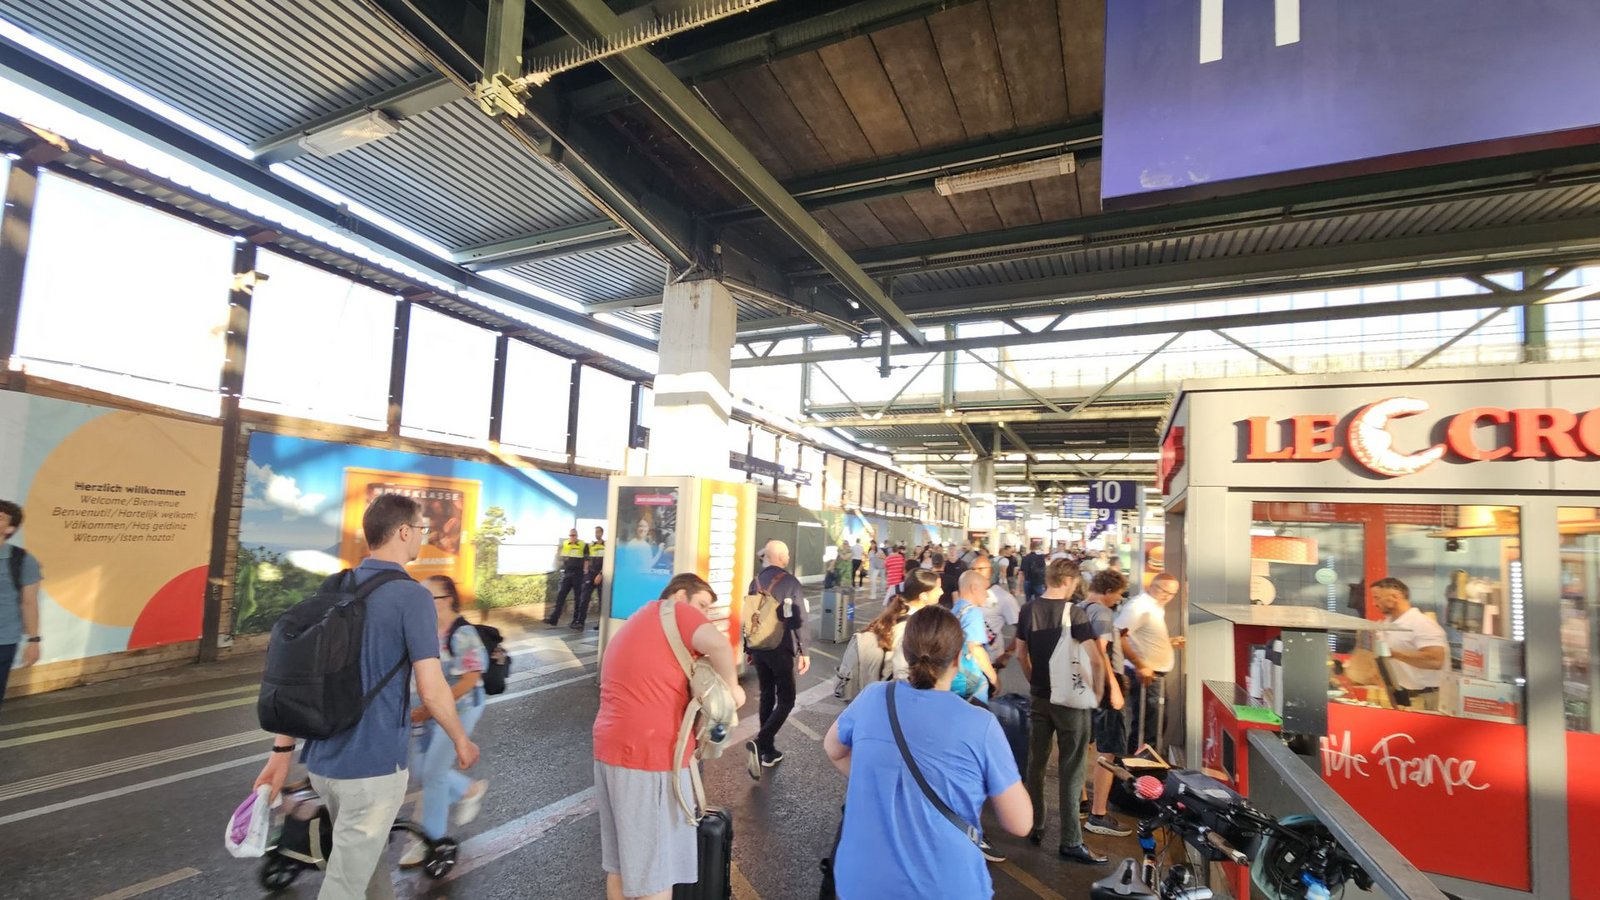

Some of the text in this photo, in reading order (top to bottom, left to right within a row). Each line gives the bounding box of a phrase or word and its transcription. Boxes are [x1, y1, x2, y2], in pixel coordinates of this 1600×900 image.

[1246, 413, 1343, 460] LE
[74, 482, 187, 496] Herzlich willkommen
[1091, 481, 1121, 503] 10
[1097, 508, 1110, 521] 9
[1371, 732, 1491, 796] France
